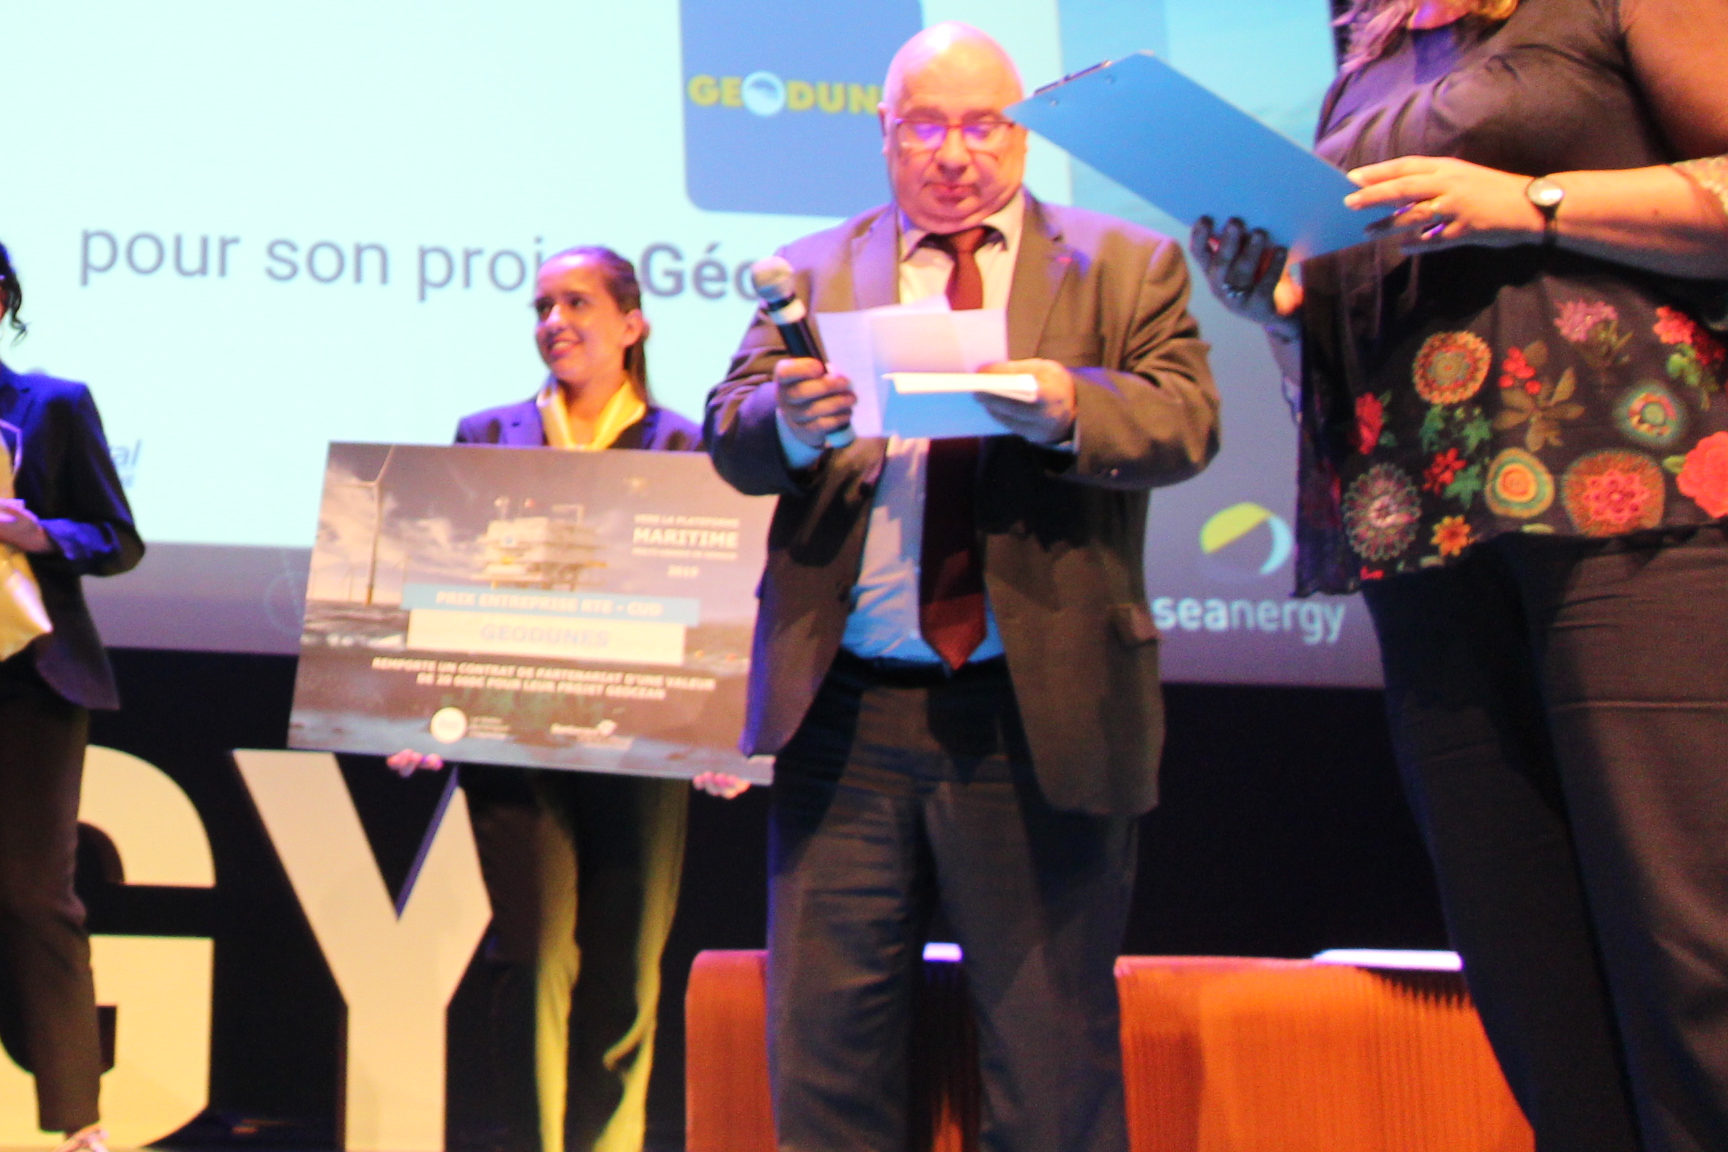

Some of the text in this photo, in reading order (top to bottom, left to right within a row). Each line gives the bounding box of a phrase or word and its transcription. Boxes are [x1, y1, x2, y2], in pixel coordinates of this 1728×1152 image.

[687, 70, 884, 116] GEODUN
[79, 228, 242, 289] pour
[264, 237, 391, 287] son
[633, 527, 739, 549] MARITIME
[435, 590, 477, 607] PRIX
[480, 623, 610, 648] GEODUNES
[1151, 596, 1348, 645] seanergy
